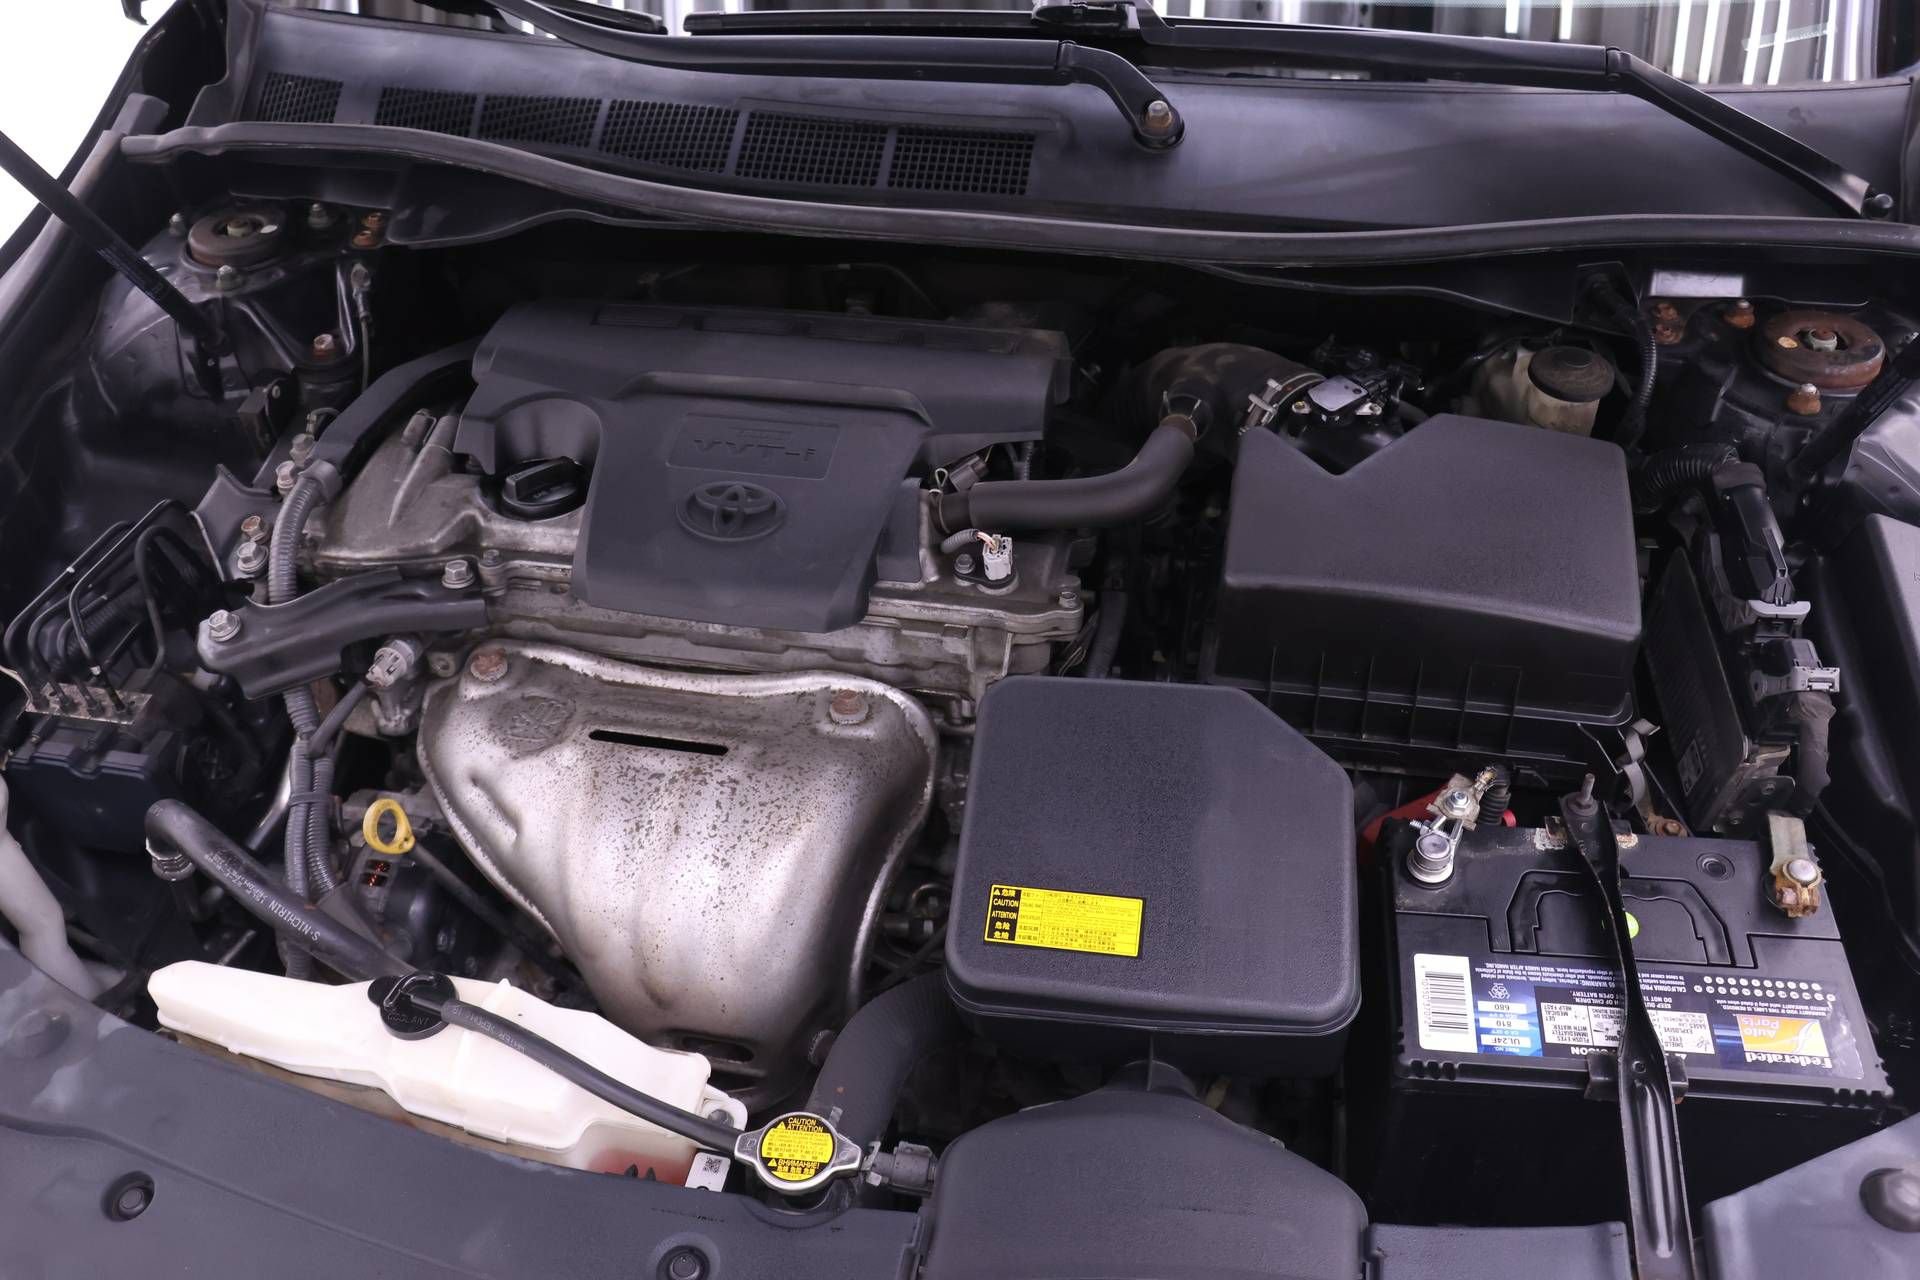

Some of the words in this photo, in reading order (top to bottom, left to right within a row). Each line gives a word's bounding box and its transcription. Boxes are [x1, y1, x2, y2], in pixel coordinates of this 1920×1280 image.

[993, 898, 1019, 907] CAUTION
[992, 910, 1017, 919] ATTENTION
[1654, 985, 1686, 993] CALIFORNIA
[1742, 1017, 1780, 1029] Parts
[1744, 1027, 1777, 1039] Auto
[1491, 1037, 1520, 1045] UL24F
[1745, 1052, 1833, 1069] Federated
[788, 1117, 816, 1126] CAUTION
[787, 1124, 823, 1133] ATTENTION
